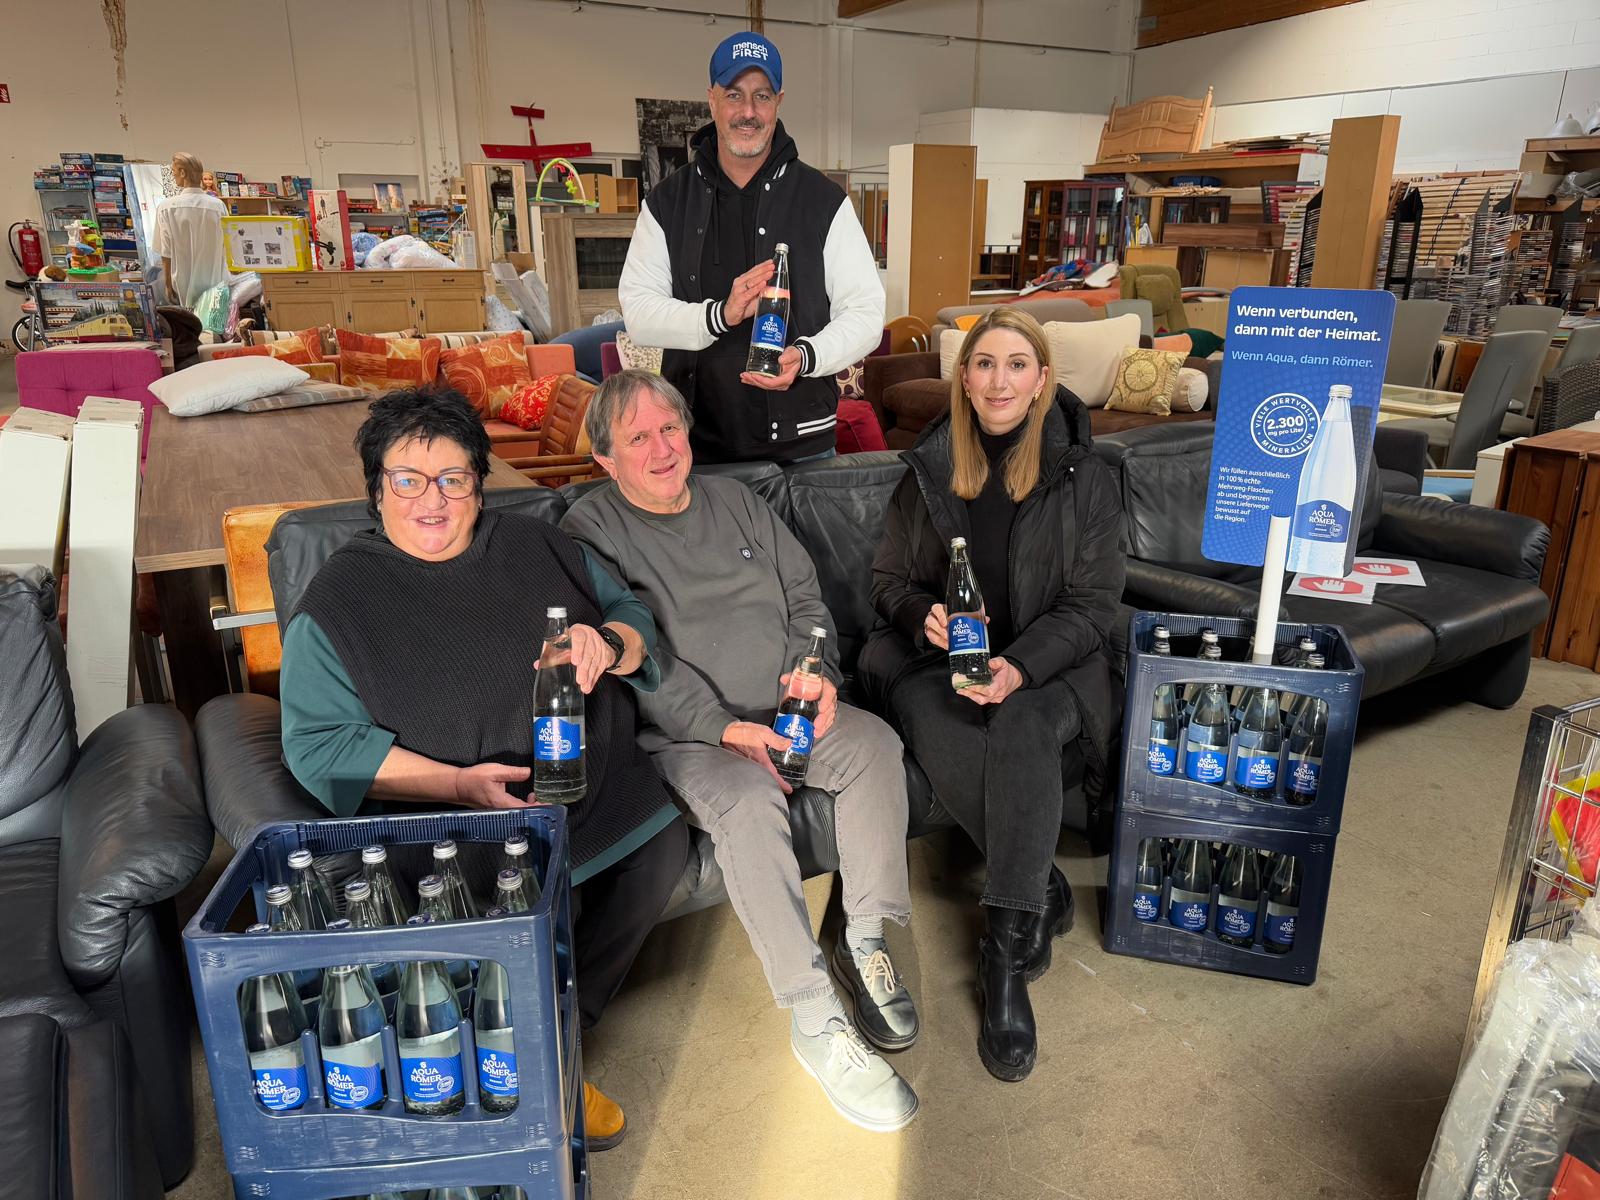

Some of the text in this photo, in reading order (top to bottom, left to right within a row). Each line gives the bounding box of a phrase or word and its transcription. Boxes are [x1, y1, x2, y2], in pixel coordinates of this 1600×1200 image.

[732, 42, 767, 53] mensch
[1236, 305, 1358, 323] Wenn verbunden,
[1234, 324, 1381, 342] dann mit der Heimat.
[1231, 350, 1374, 368] Wenn Aqua, dann Römer.
[1256, 398, 1315, 428] VIELE WERTVOLLE
[1267, 416, 1304, 430] 2.300
[1261, 433, 1314, 454] MINERALIEN
[1248, 470, 1290, 479] ausschließlich
[1238, 493, 1270, 502] begrenzen
[1215, 506, 1240, 514] bewusst
[1236, 500, 1270, 510] Lieferwege
[1224, 514, 1246, 522] Region.
[1311, 510, 1334, 518] AQUA
[787, 723, 804, 732] AUA
[483, 1058, 507, 1068] AQUA
[328, 1071, 352, 1081] AQUA
[412, 1068, 439, 1076] AQUA
[256, 1079, 284, 1087] AQUA
